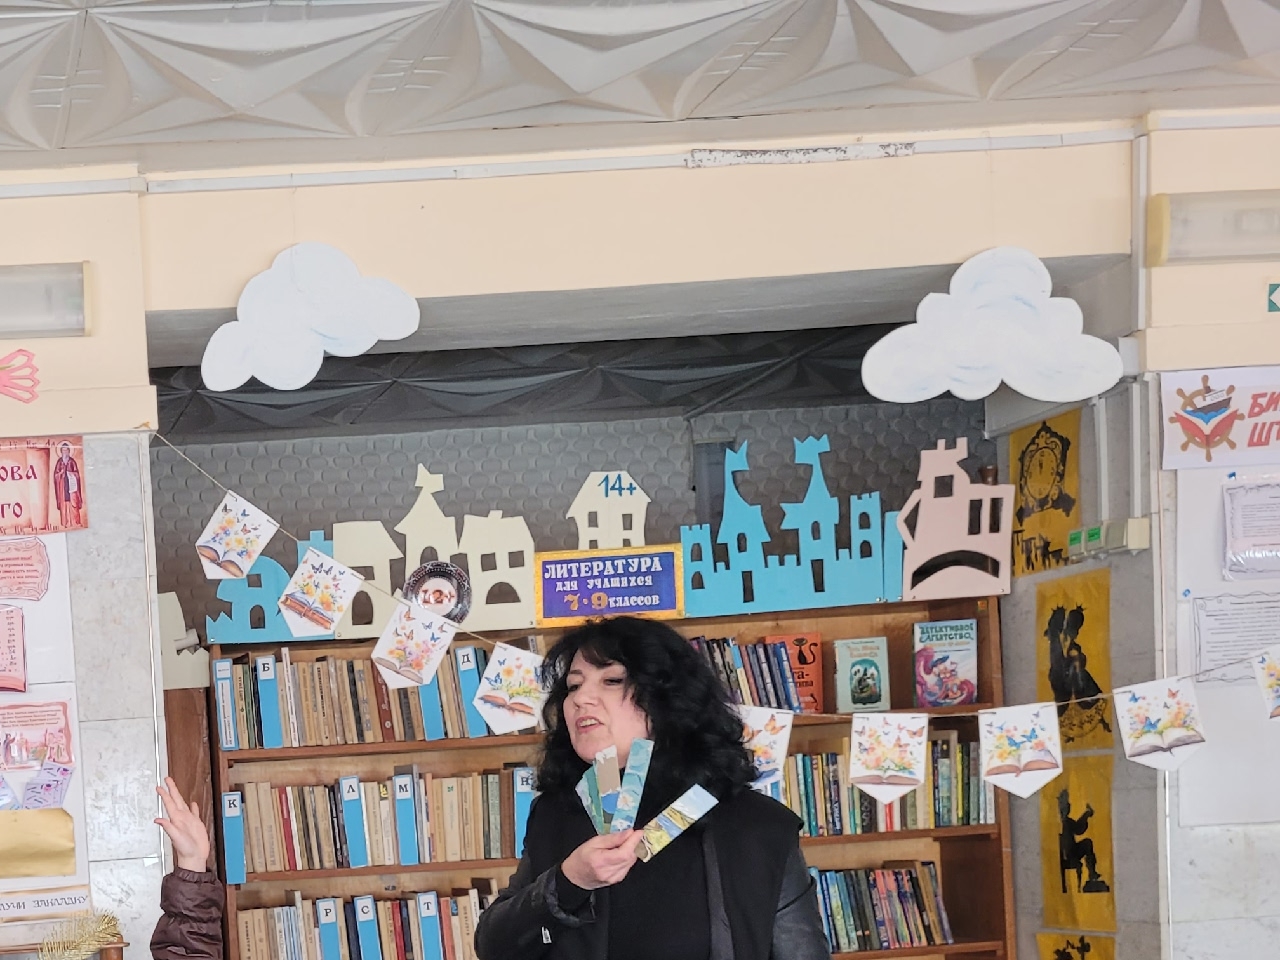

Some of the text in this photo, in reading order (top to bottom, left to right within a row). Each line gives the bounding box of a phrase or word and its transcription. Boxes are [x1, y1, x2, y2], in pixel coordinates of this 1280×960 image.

[598, 473, 637, 498] 14+
[544, 556, 663, 579] ЛИТЕРАТУРА
[462, 654, 470, 665] Д
[262, 663, 269, 672] Б
[347, 785, 355, 793] Л
[399, 784, 408, 792] М
[228, 799, 237, 808] К
[361, 906, 369, 914] С
[423, 901, 432, 911] Т
